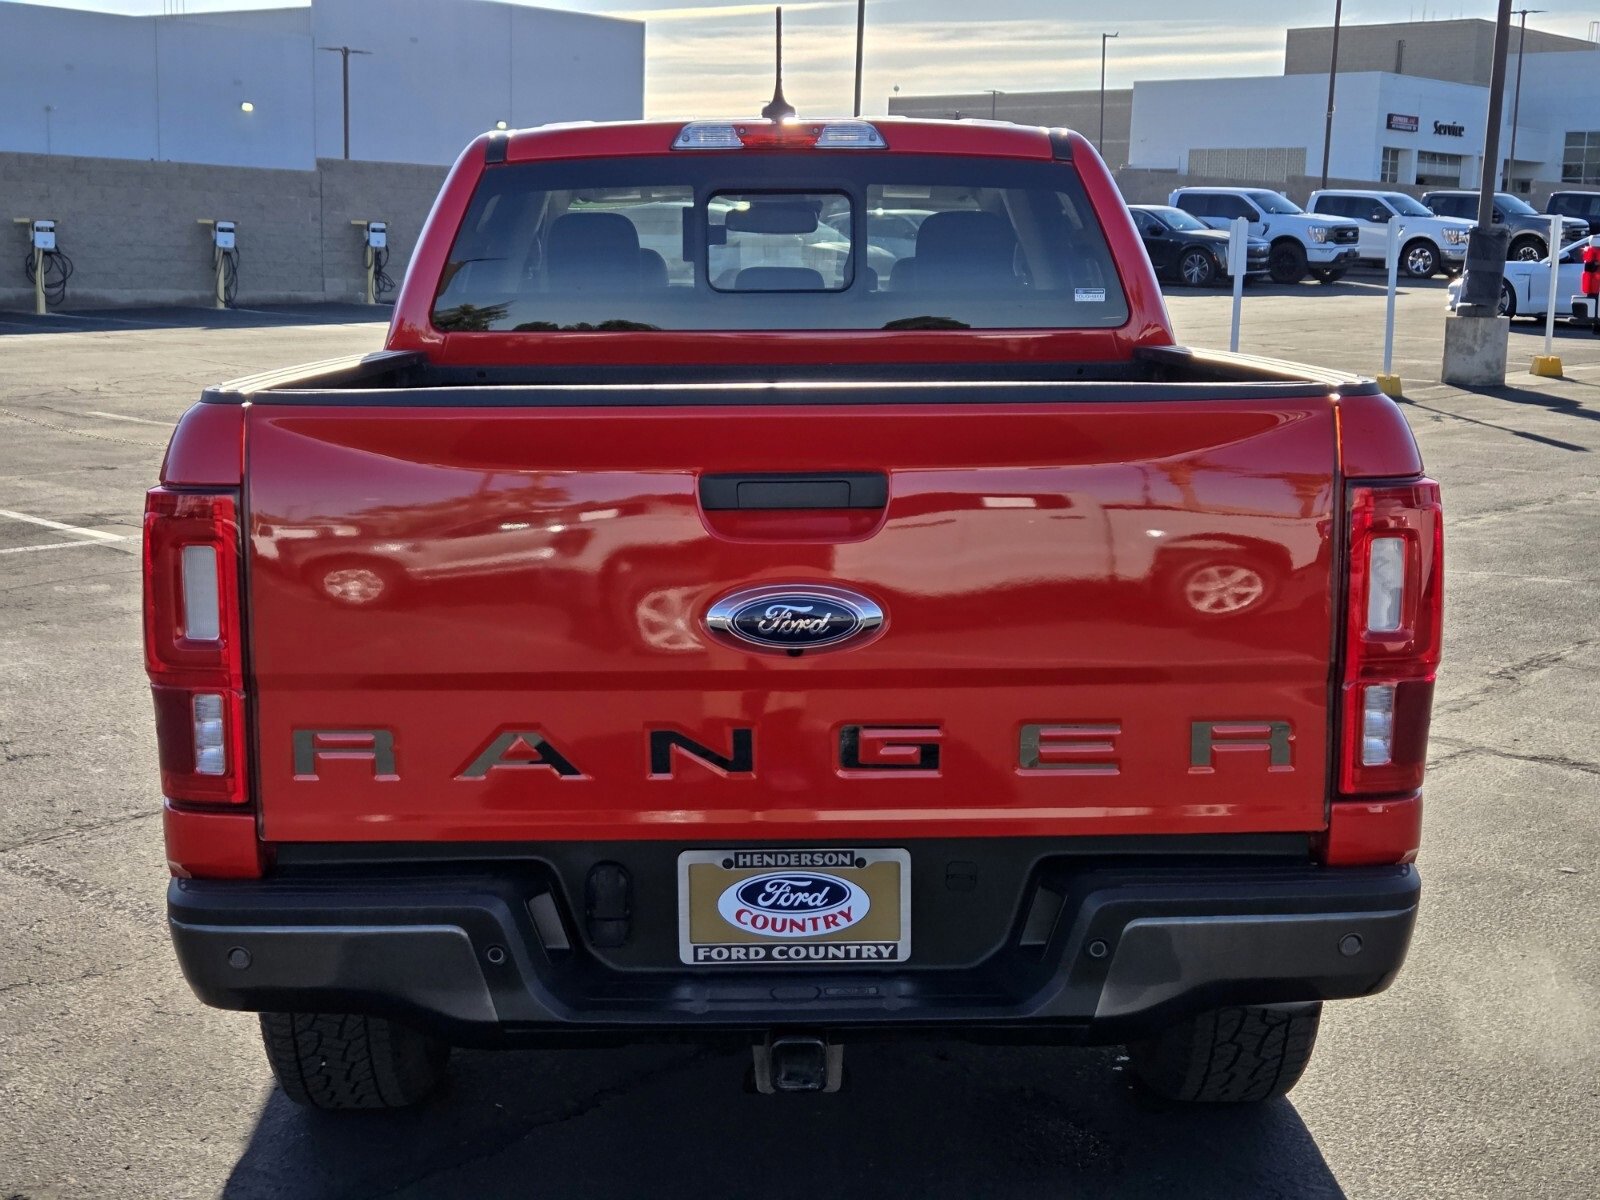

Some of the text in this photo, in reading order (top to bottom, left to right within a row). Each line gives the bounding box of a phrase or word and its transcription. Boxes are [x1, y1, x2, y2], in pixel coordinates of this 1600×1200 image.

[1433, 120, 1465, 137] Service
[758, 604, 832, 635] Ford
[291, 719, 1297, 782] RANGER
[738, 852, 851, 867] HENDERSON
[757, 879, 831, 908] Ford
[734, 906, 854, 934] COUNTRY
[697, 945, 895, 961] FORD COUNTRY
